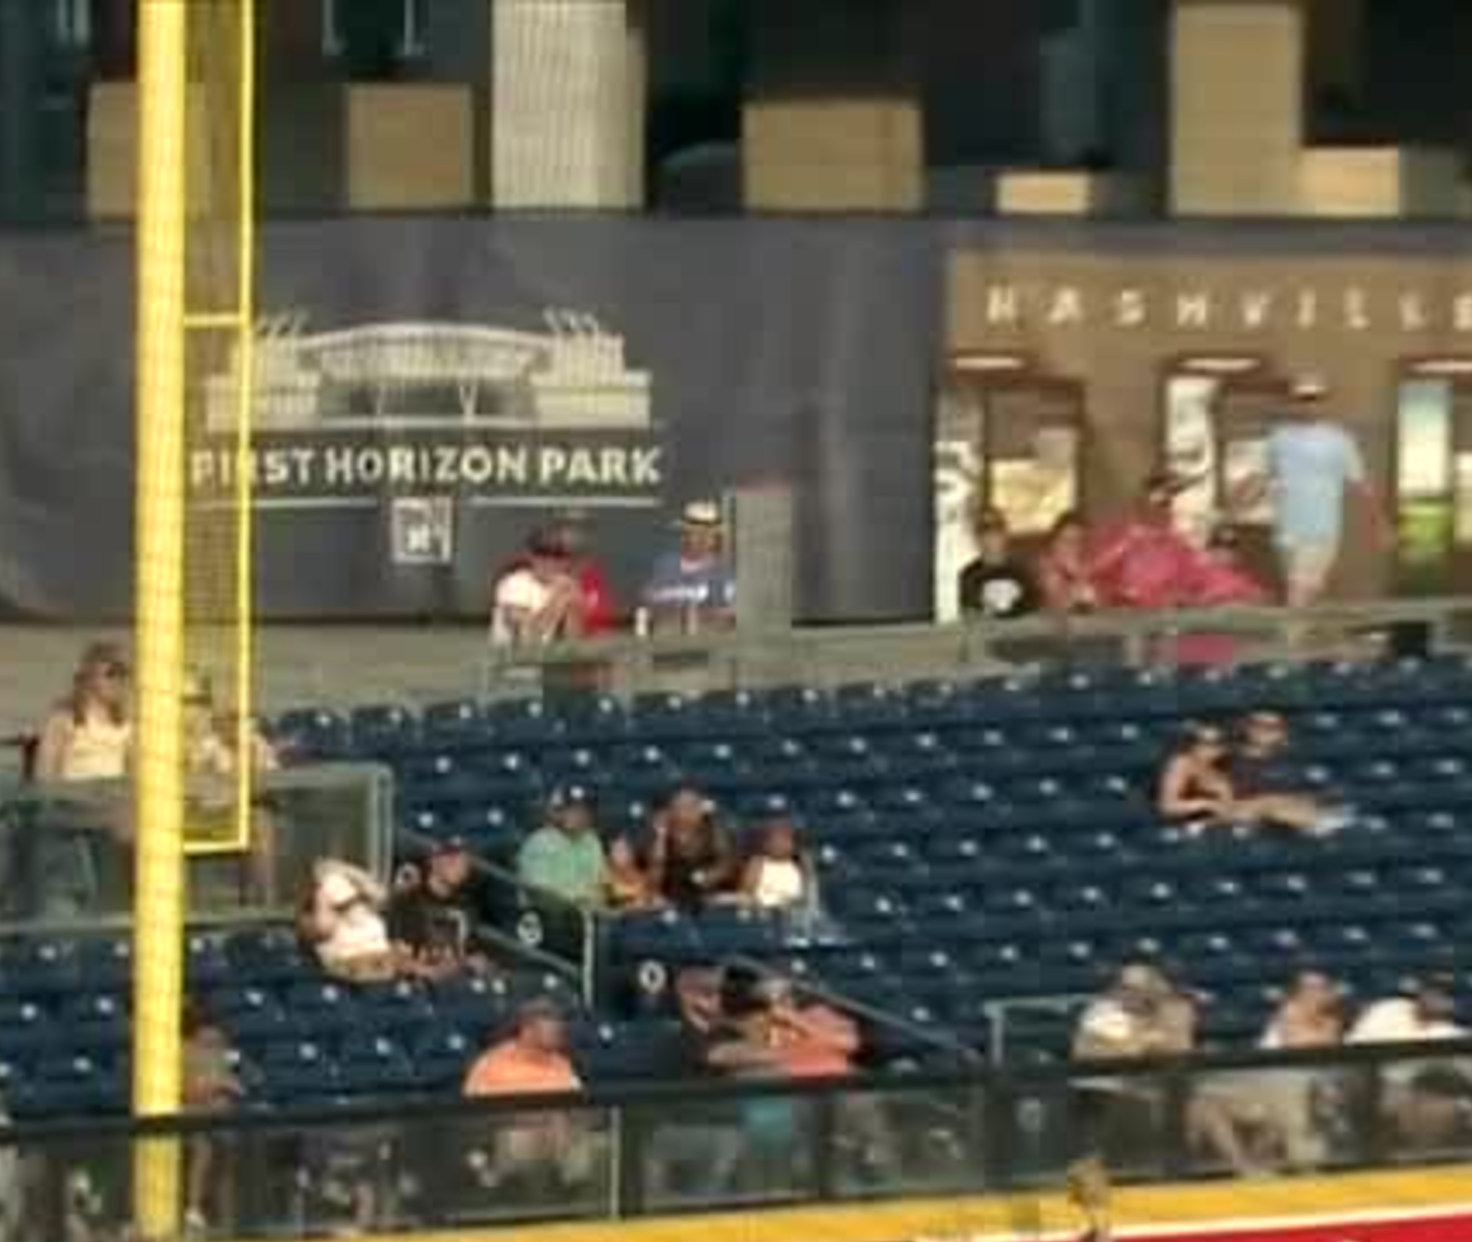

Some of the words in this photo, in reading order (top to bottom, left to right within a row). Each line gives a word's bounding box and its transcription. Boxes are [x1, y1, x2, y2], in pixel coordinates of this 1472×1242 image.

[190, 449, 314, 484] FIRST
[325, 447, 528, 484] HORIZON
[539, 447, 664, 484] PARK
